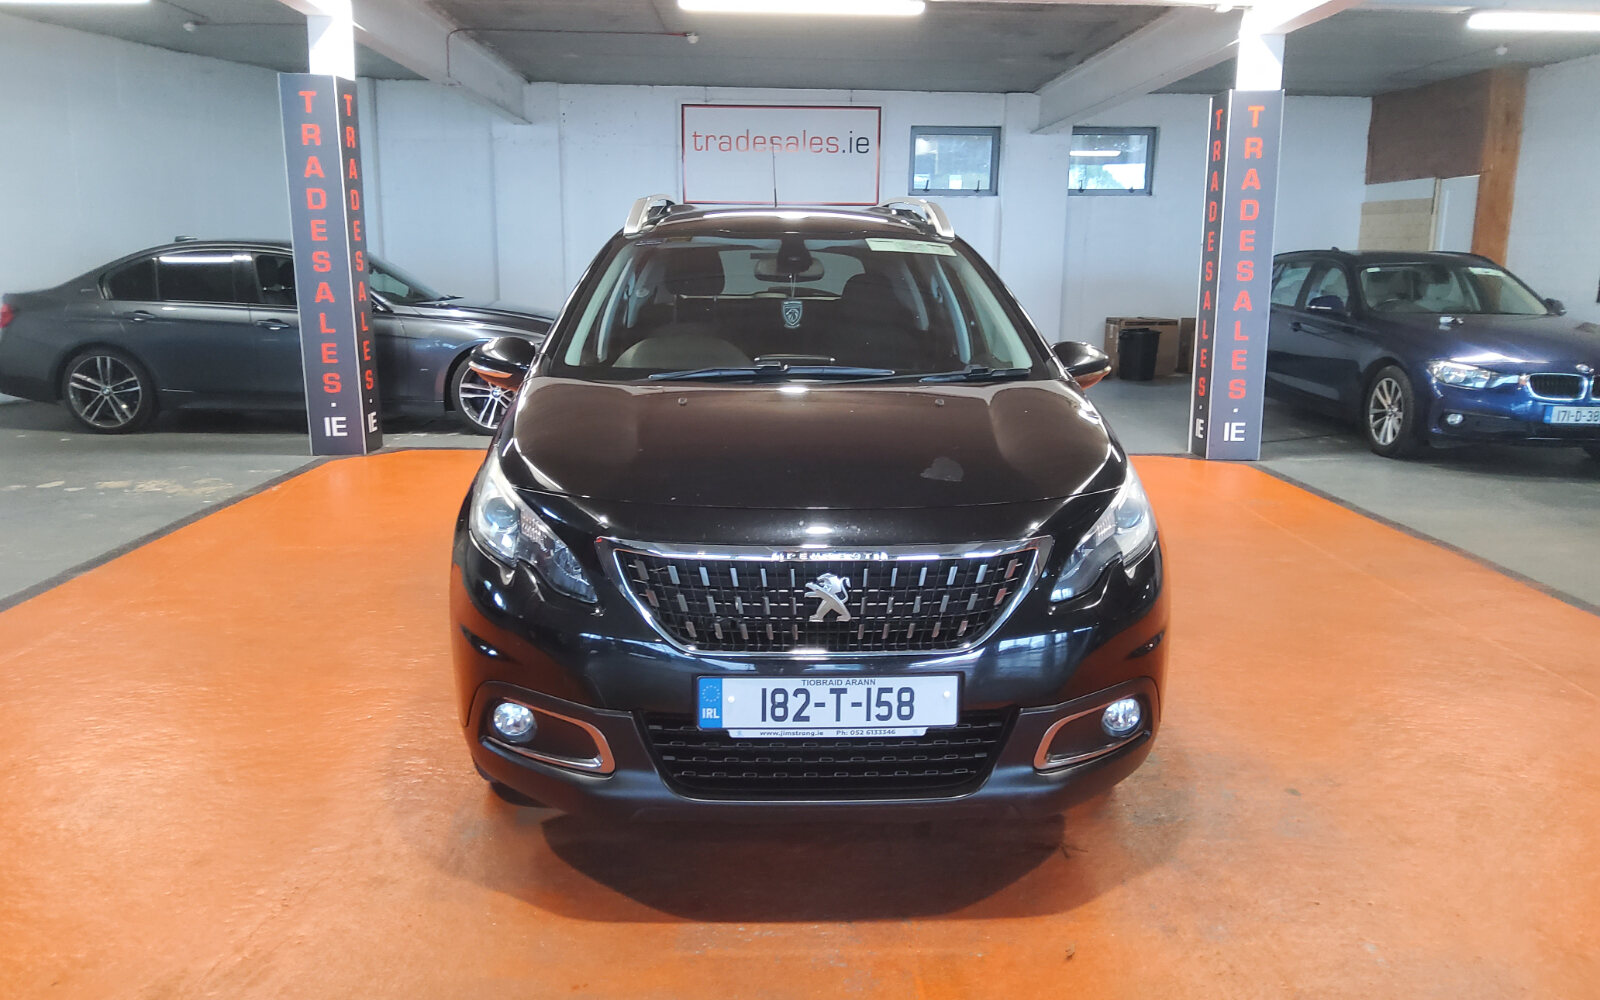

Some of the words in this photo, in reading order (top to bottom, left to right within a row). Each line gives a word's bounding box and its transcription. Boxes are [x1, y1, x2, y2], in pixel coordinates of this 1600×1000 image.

[692, 128, 870, 154] tradesales.ie
[802, 679, 843, 687] TIOBRAID
[845, 678, 876, 686] ARANN
[702, 708, 720, 719] IRL
[761, 687, 915, 722] 182-T-158
